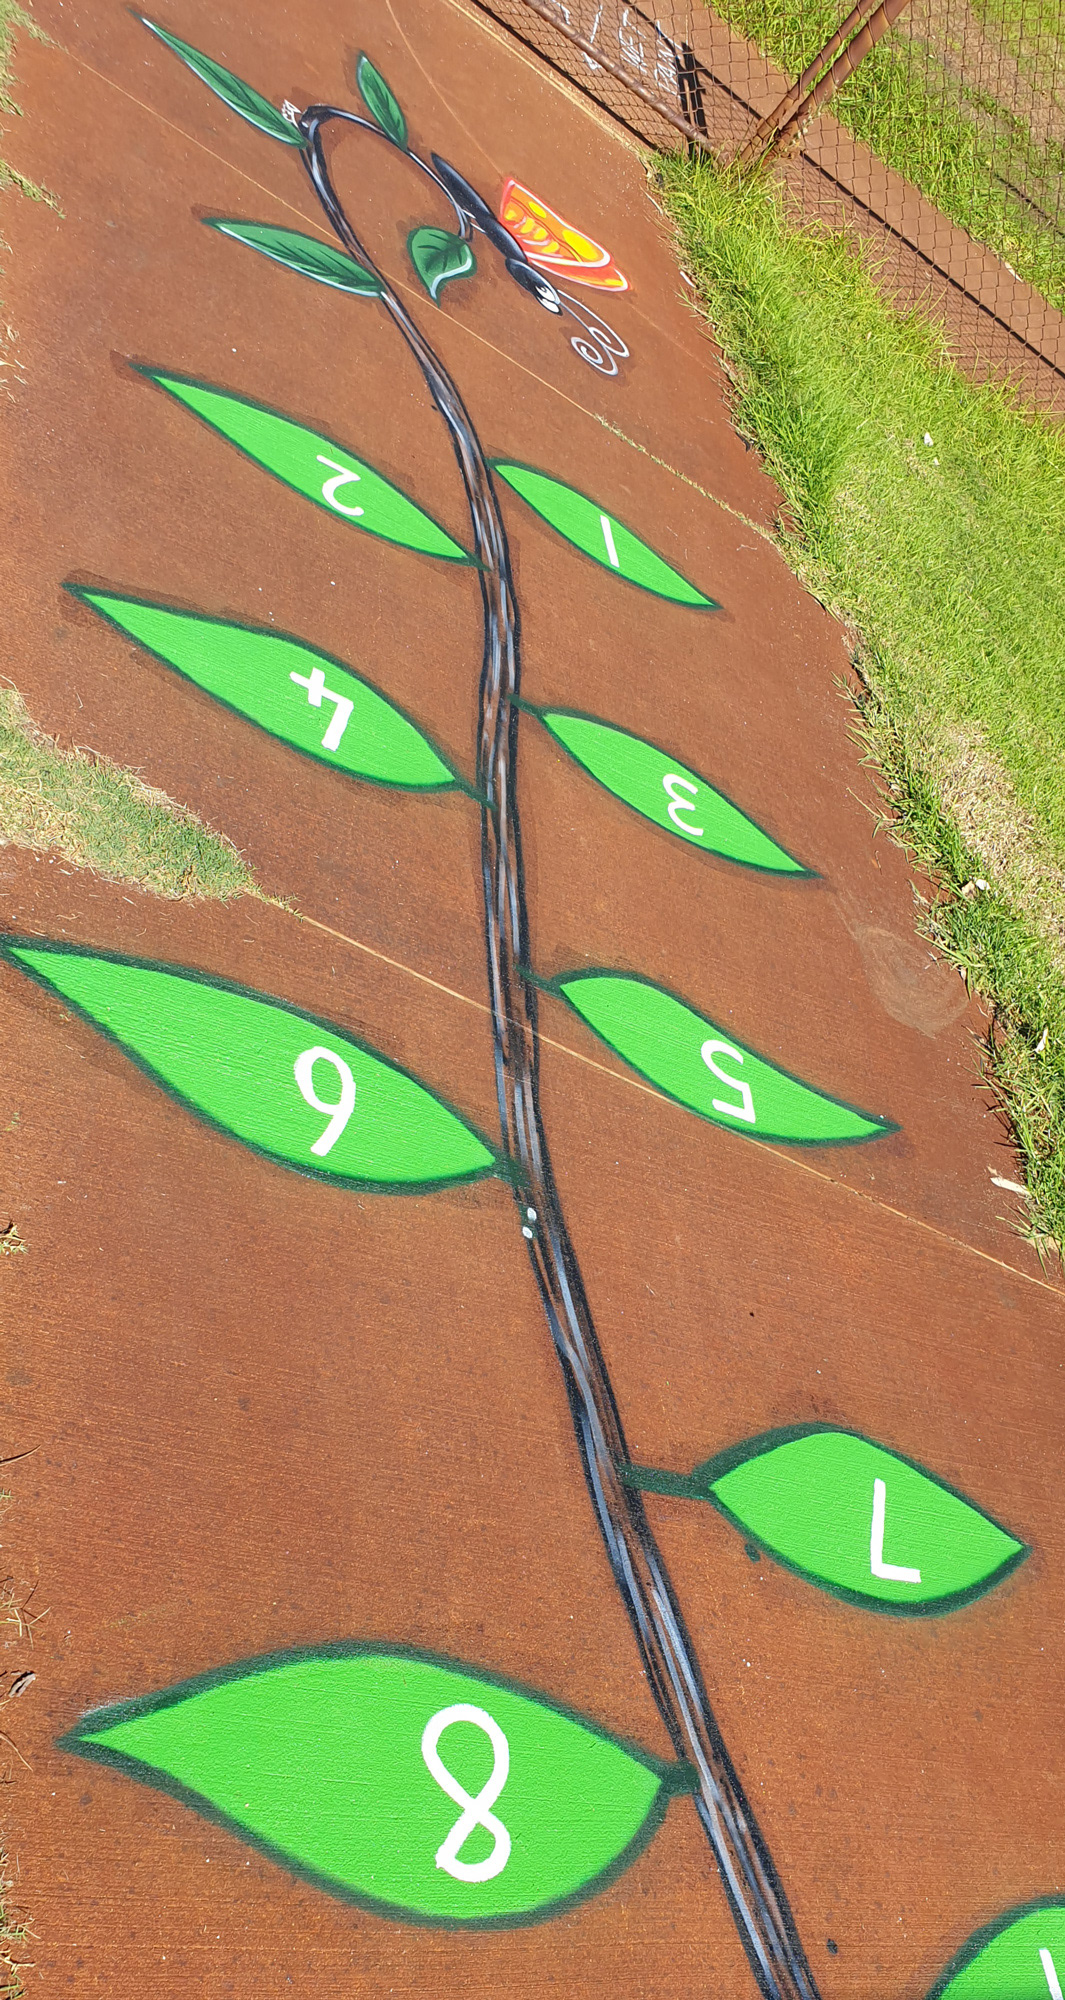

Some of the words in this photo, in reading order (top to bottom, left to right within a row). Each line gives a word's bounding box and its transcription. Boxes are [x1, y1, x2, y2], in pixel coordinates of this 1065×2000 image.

[618, 8, 648, 75] WET
[317, 455, 364, 517] 2
[600, 515, 620, 568] 1
[290, 668, 354, 752] 4
[660, 772, 705, 837] 3
[294, 1046, 356, 1157] 6
[701, 1040, 757, 1123] 5
[870, 1478, 922, 1584] 7
[421, 1704, 512, 1884] 8
